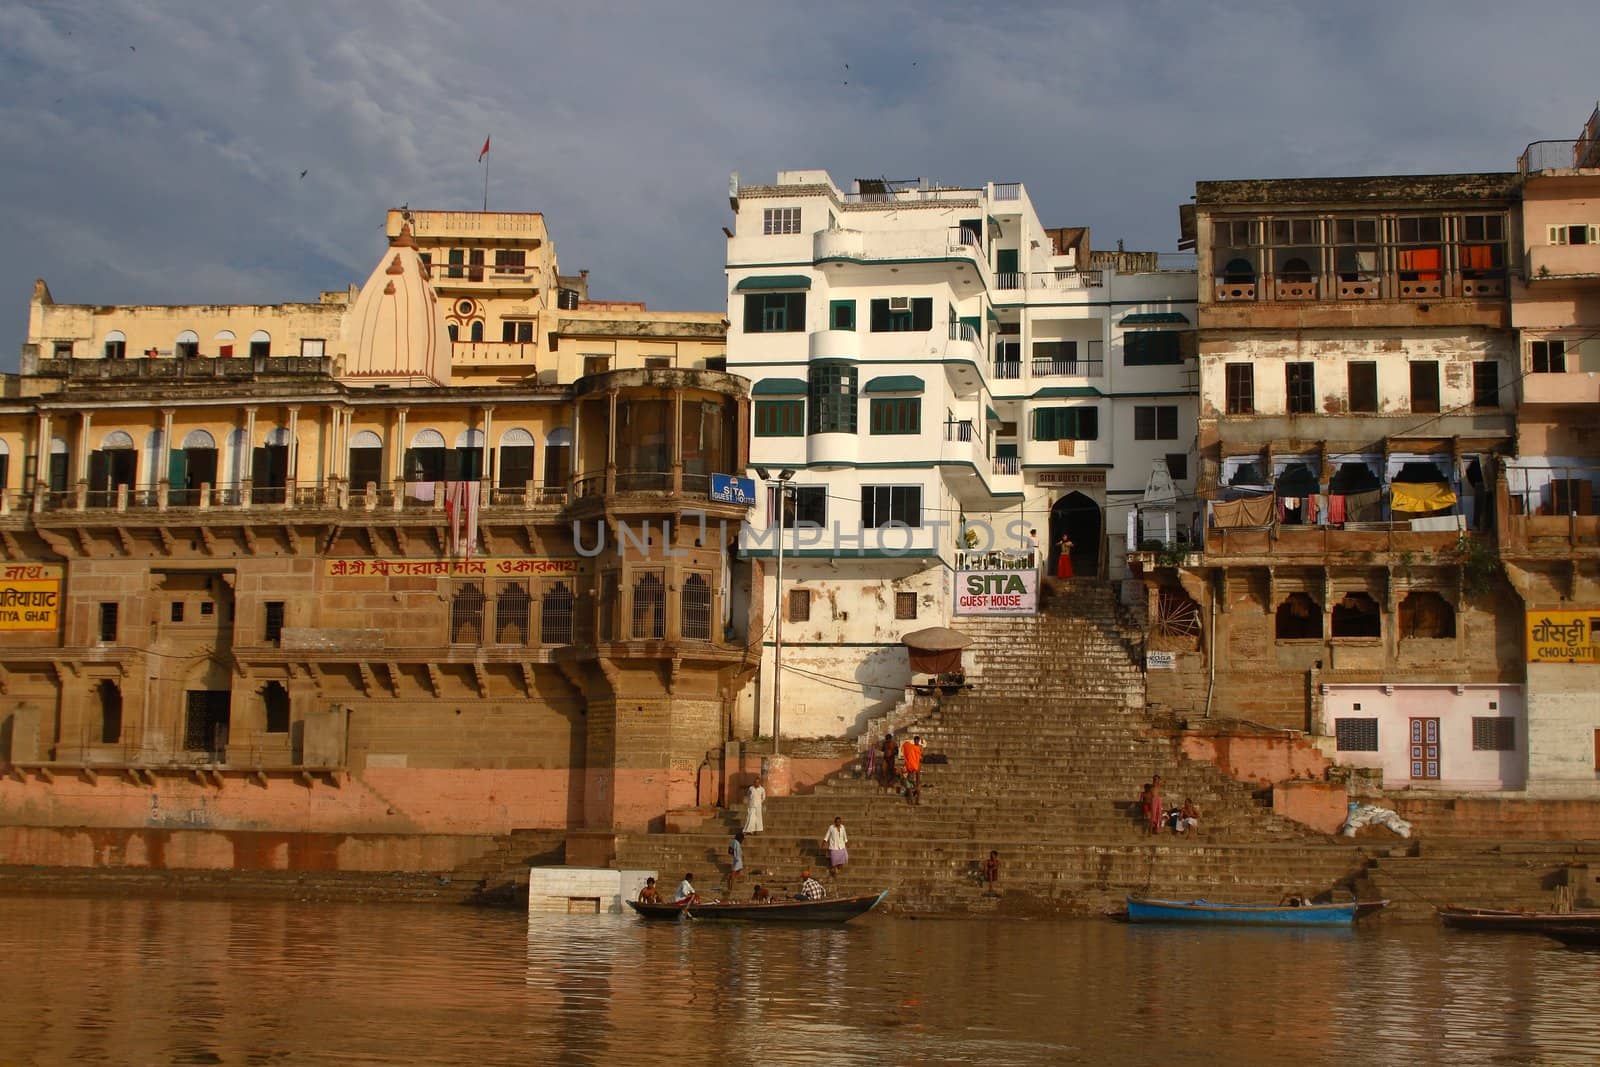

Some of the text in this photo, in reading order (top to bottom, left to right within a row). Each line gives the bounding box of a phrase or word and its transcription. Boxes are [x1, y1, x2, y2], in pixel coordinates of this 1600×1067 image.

[723, 486, 745, 497] SITA
[966, 574, 1028, 595] SITA
[960, 595, 1021, 606] GUEST HOUSE
[25, 611, 50, 621] GHAT
[1532, 617, 1585, 646] चौसट्टी
